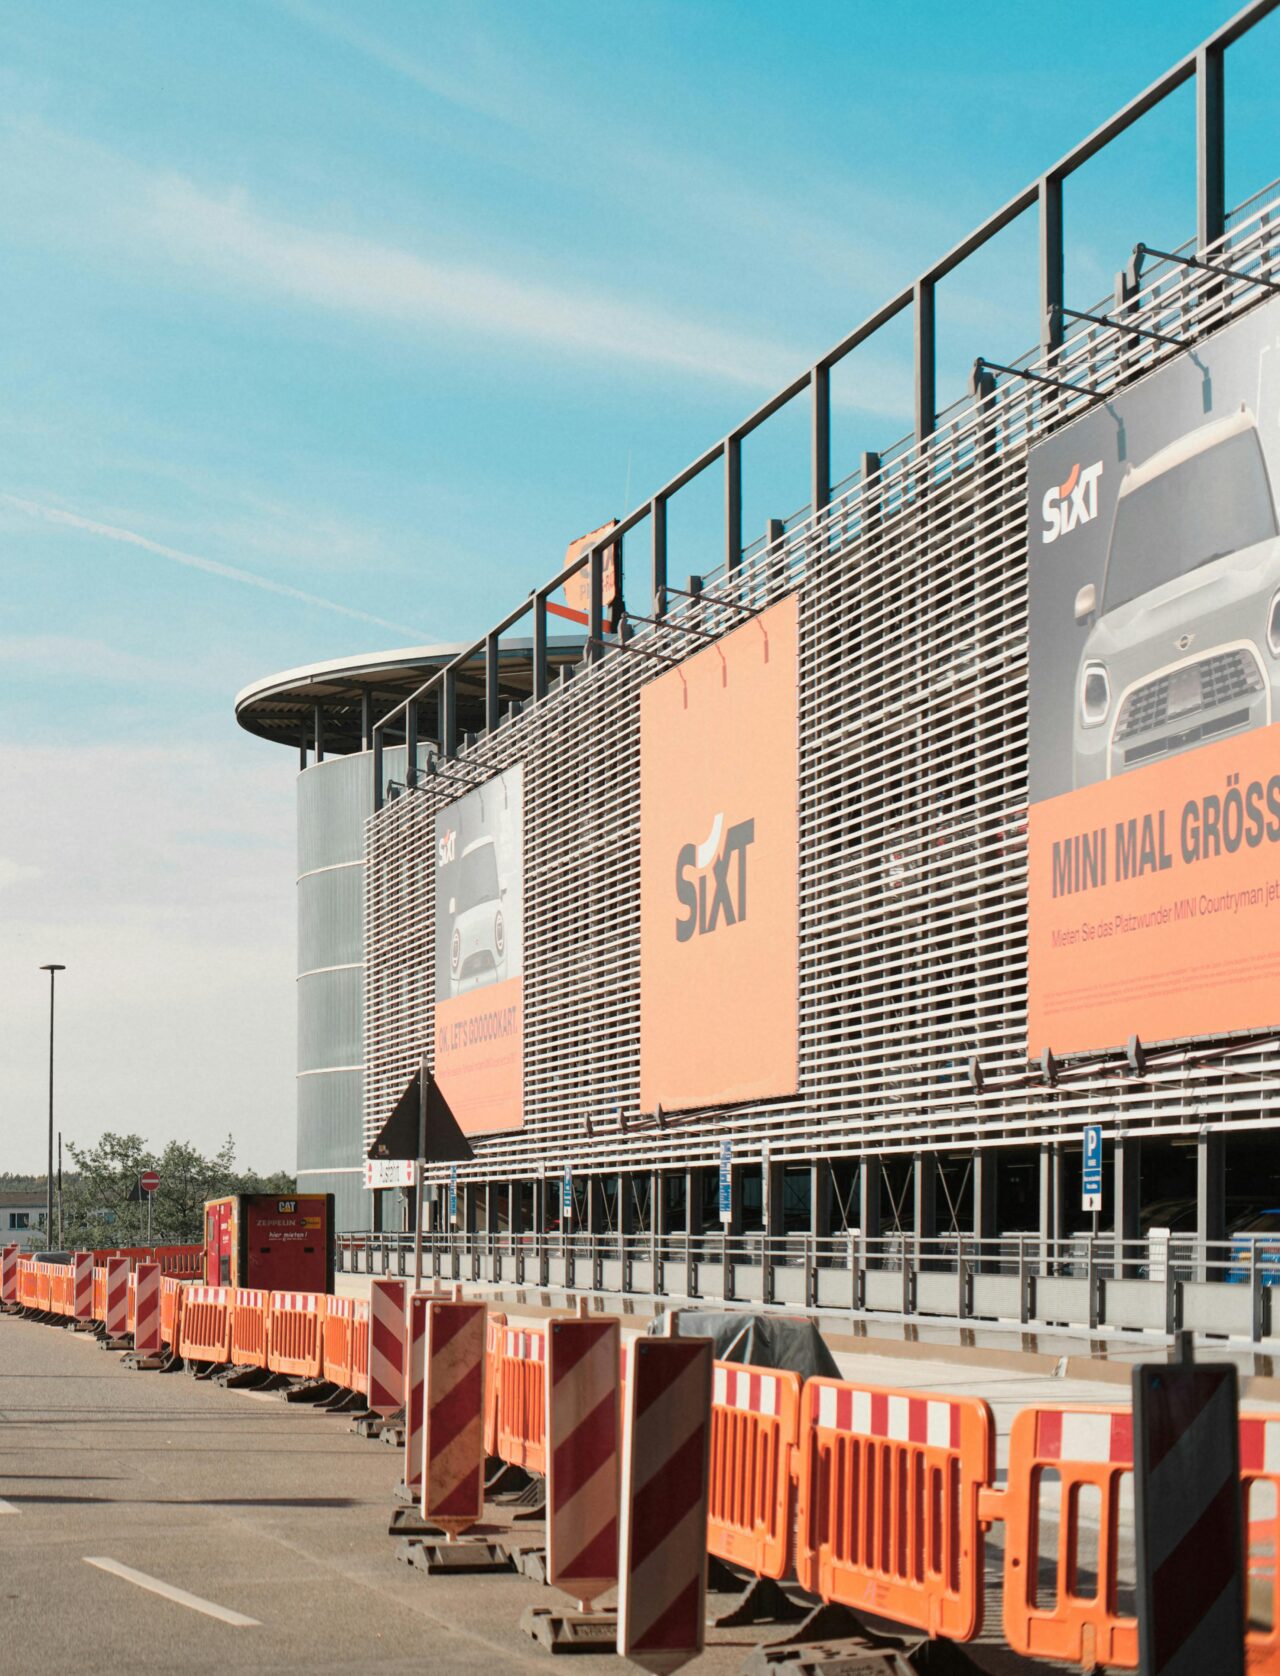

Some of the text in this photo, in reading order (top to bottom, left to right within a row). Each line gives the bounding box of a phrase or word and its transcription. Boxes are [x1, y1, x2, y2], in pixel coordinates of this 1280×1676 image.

[1052, 828, 1107, 899] MINI
[1115, 810, 1173, 882] MAL
[1052, 879, 1280, 948] Mieten Sie das Platzwunder MINI Countryman jet
[1088, 1130, 1097, 1157] P
[278, 1200, 296, 1213] CAT
[256, 1218, 296, 1227] ZEPPELIN
